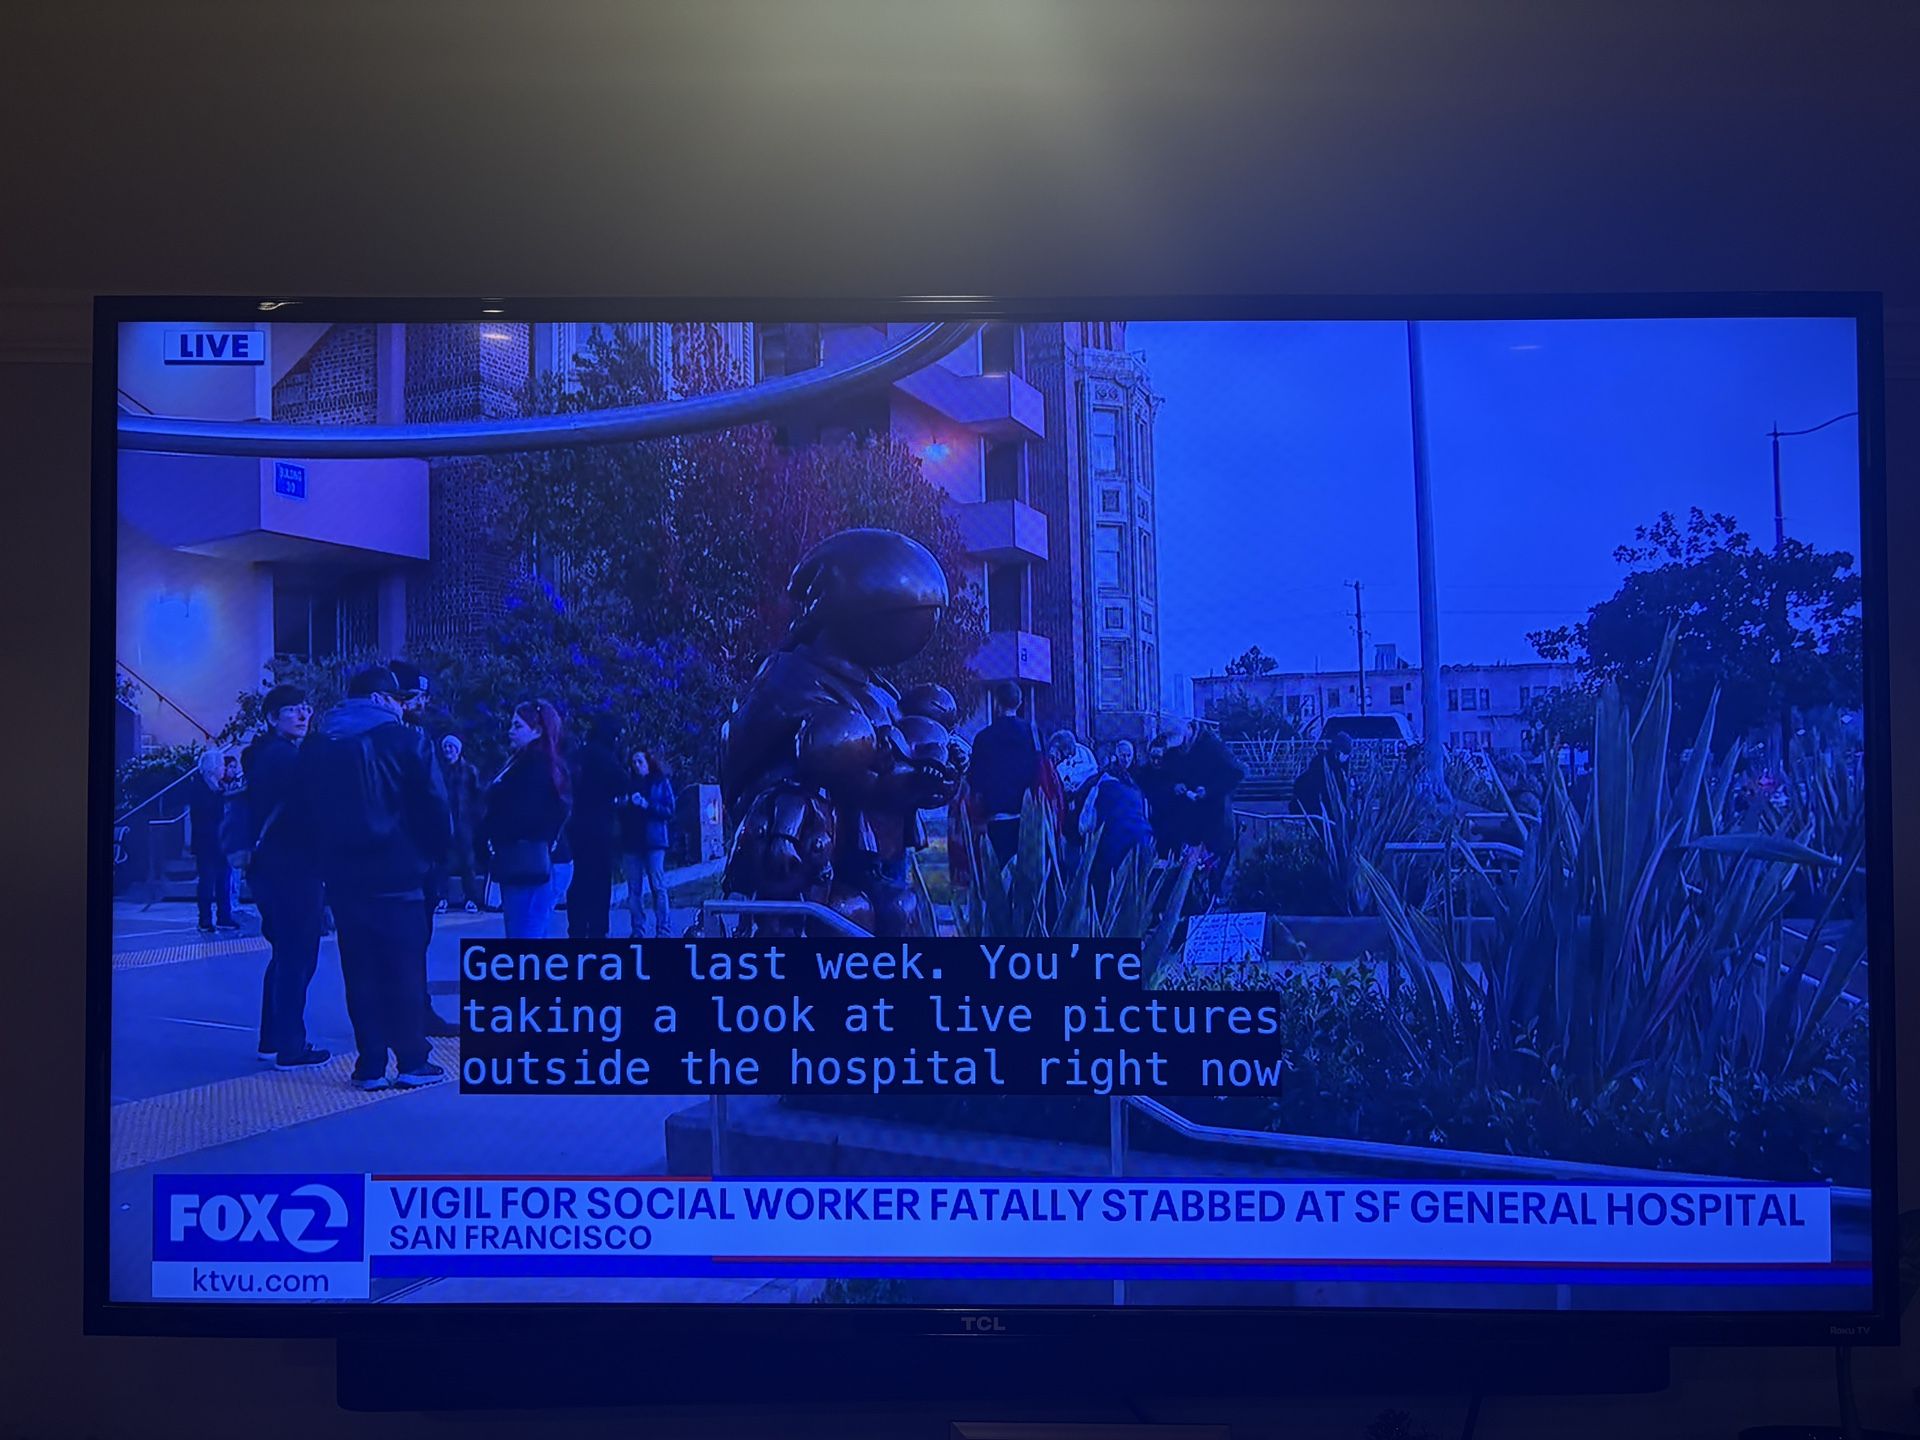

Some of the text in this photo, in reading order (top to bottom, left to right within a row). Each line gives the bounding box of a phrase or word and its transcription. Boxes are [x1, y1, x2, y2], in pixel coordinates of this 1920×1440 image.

[180, 334, 249, 358] LIVE
[463, 943, 651, 981] General
[685, 943, 786, 980] last
[815, 942, 942, 980] week.
[463, 995, 1278, 1042] taking a look at live pictures
[463, 1047, 1283, 1092] outside the hospital right now
[170, 1193, 279, 1242] FOX
[389, 1186, 1806, 1227] VIGIL FOR SOCIAL WORKER FATALLY STABBED AT SF GENERAL HOSPITAL
[389, 1224, 652, 1250] SAN FRANCISCO
[193, 1267, 329, 1293] ktvu.com
[961, 1316, 1006, 1331] TCL
[1829, 1326, 1872, 1335] Roku TV
